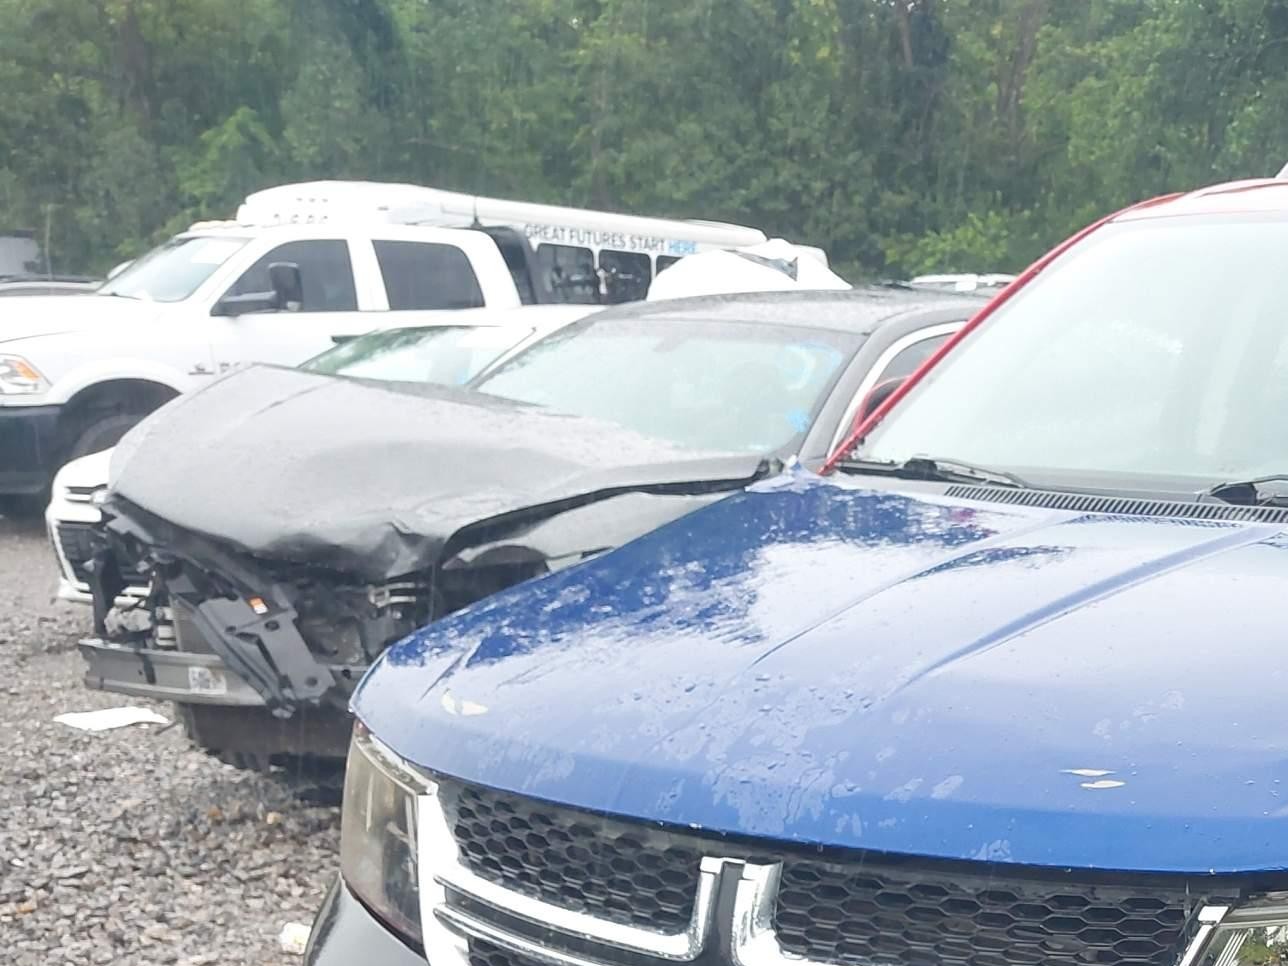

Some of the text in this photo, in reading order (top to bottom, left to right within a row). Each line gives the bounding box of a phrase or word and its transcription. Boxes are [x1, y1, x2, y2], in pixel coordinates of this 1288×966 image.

[525, 223, 566, 241] GREAT
[570, 227, 626, 248] FUTURES
[630, 233, 665, 251] START
